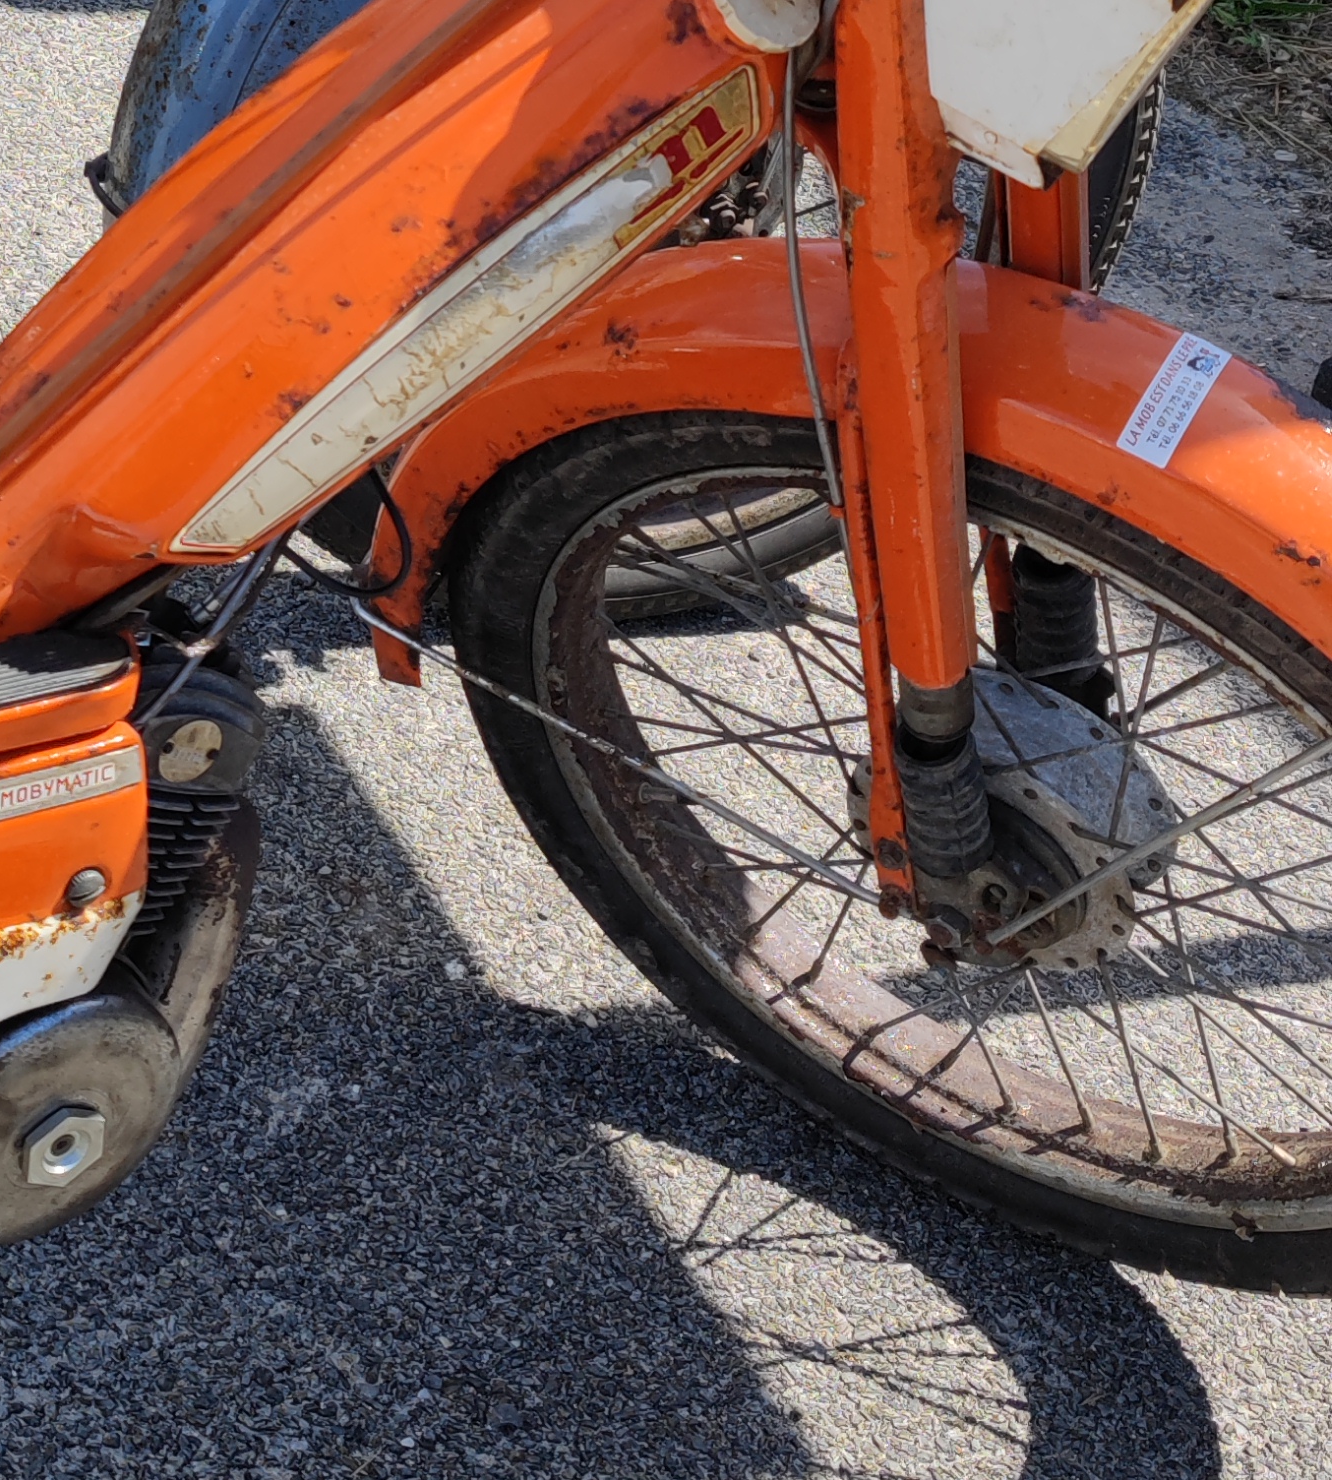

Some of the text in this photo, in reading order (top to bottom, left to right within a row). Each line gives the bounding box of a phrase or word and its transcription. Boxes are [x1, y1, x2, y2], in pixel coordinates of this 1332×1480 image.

[1125, 430, 1141, 446] LA
[1134, 402, 1155, 430] MOB
[1149, 383, 1166, 404] EST
[1160, 359, 1182, 387] DANS
[1175, 349, 1189, 362] LE
[1156, 416, 1167, 427] 07
[0, 764, 114, 809] MOBYMATIC
